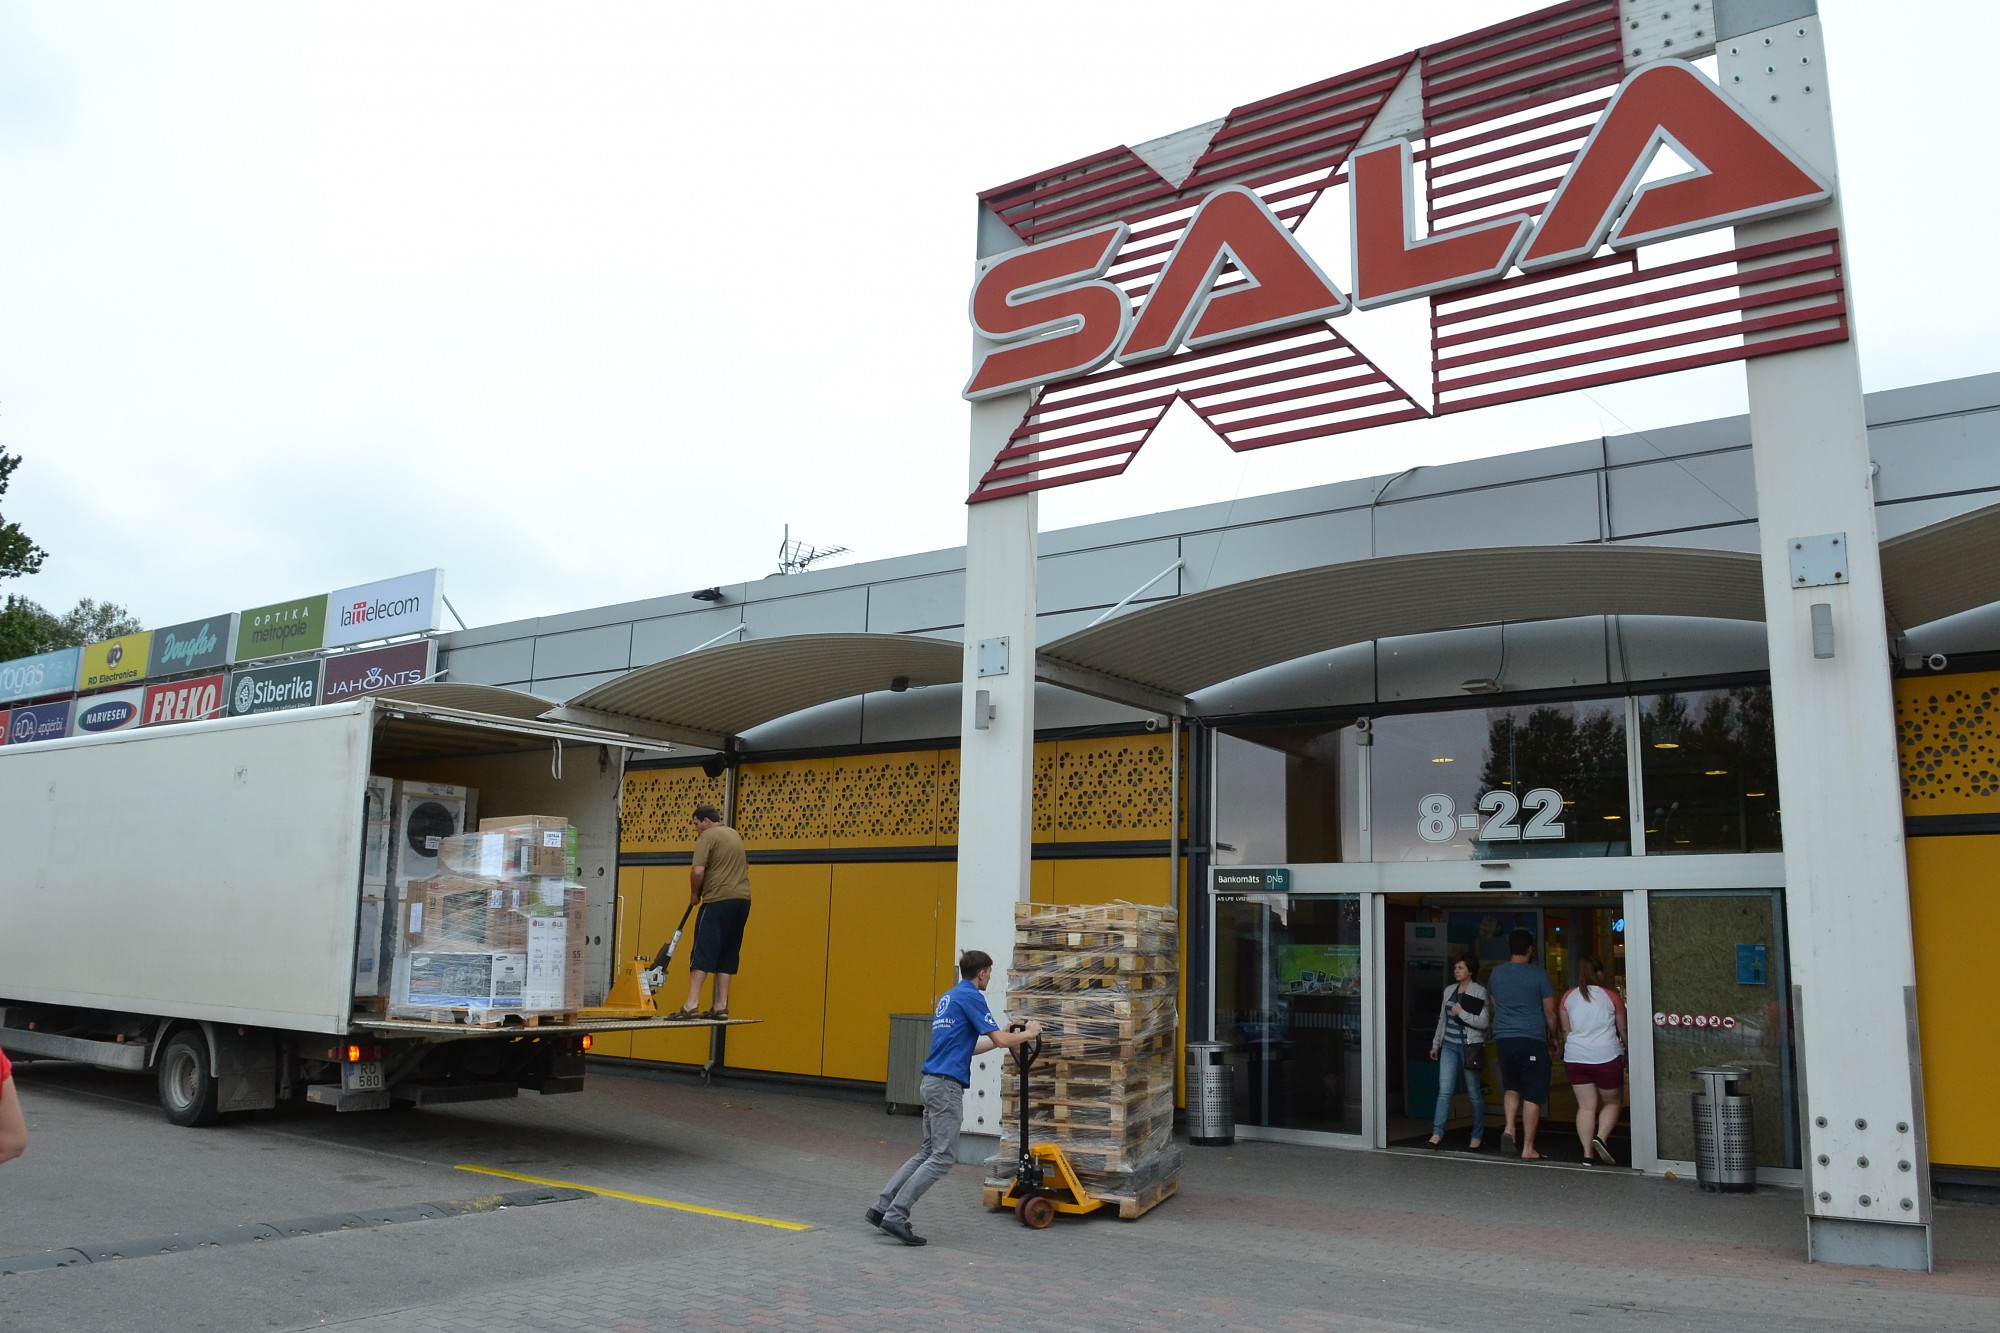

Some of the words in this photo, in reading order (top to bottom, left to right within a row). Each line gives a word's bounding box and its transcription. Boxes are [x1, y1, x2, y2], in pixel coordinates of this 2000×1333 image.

[962, 57, 1832, 401] SALA
[254, 606, 309, 627] OPTIKA
[161, 623, 217, 666] Douglas
[252, 620, 307, 650] metropole
[88, 676, 98, 685] RD
[99, 669, 138, 683] Electronics
[327, 669, 421, 696] JAHONTS
[253, 675, 313, 704] Siberika
[151, 684, 216, 721] FREKO
[15, 719, 34, 738] RDA
[86, 708, 127, 725] NARVESEN
[1417, 788, 1565, 843] 8-22
[1218, 875, 1260, 884] Bankomāts
[1266, 871, 1284, 887] DNB
[572, 950, 581, 959] 55
[358, 1074, 380, 1088] 580
